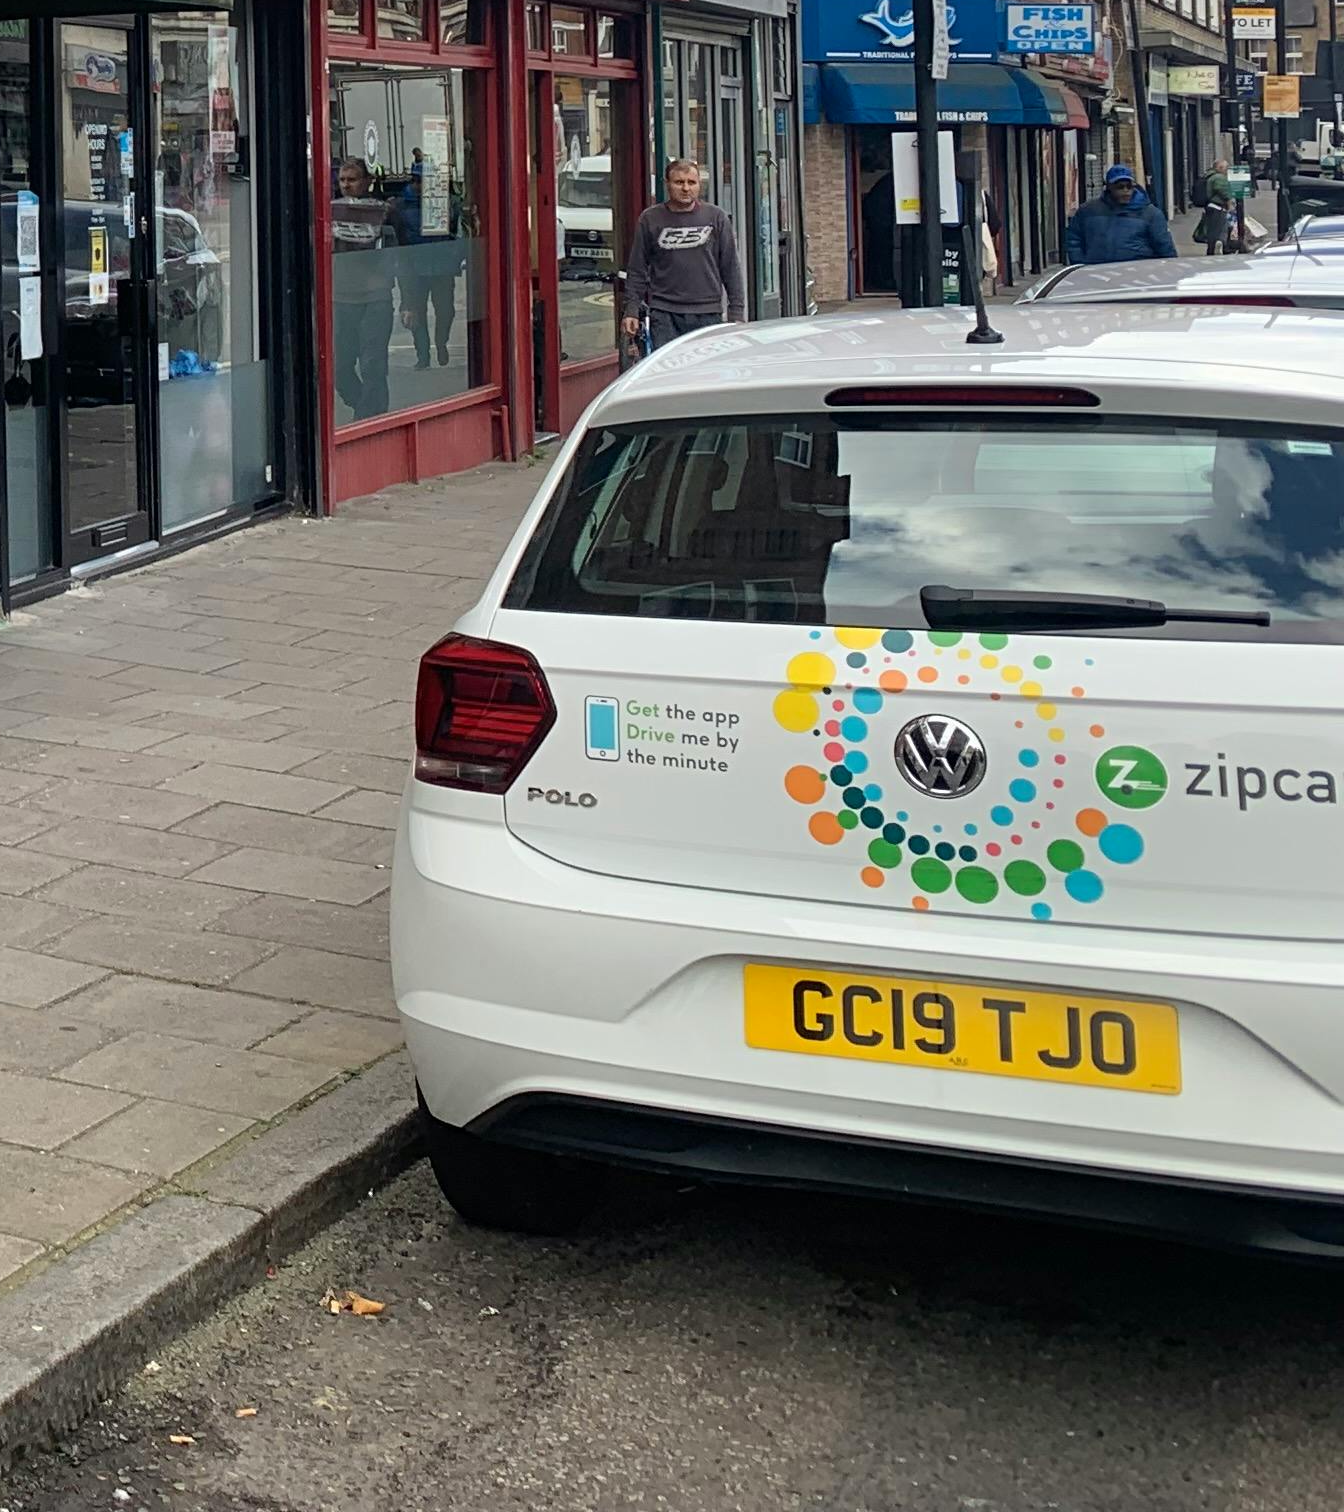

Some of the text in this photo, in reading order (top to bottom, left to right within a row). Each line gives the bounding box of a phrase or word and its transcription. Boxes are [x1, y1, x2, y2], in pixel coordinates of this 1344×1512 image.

[1023, 7, 1083, 21] FISH
[1251, 18, 1273, 27] LET
[1016, 41, 1084, 51] OPEN
[625, 699, 740, 729] Get the app
[626, 723, 740, 753] Drive me by
[626, 748, 729, 773] the minute
[1184, 752, 1344, 812] zipca
[527, 786, 598, 809] POLO
[792, 979, 1137, 1076] GC19 TJO
